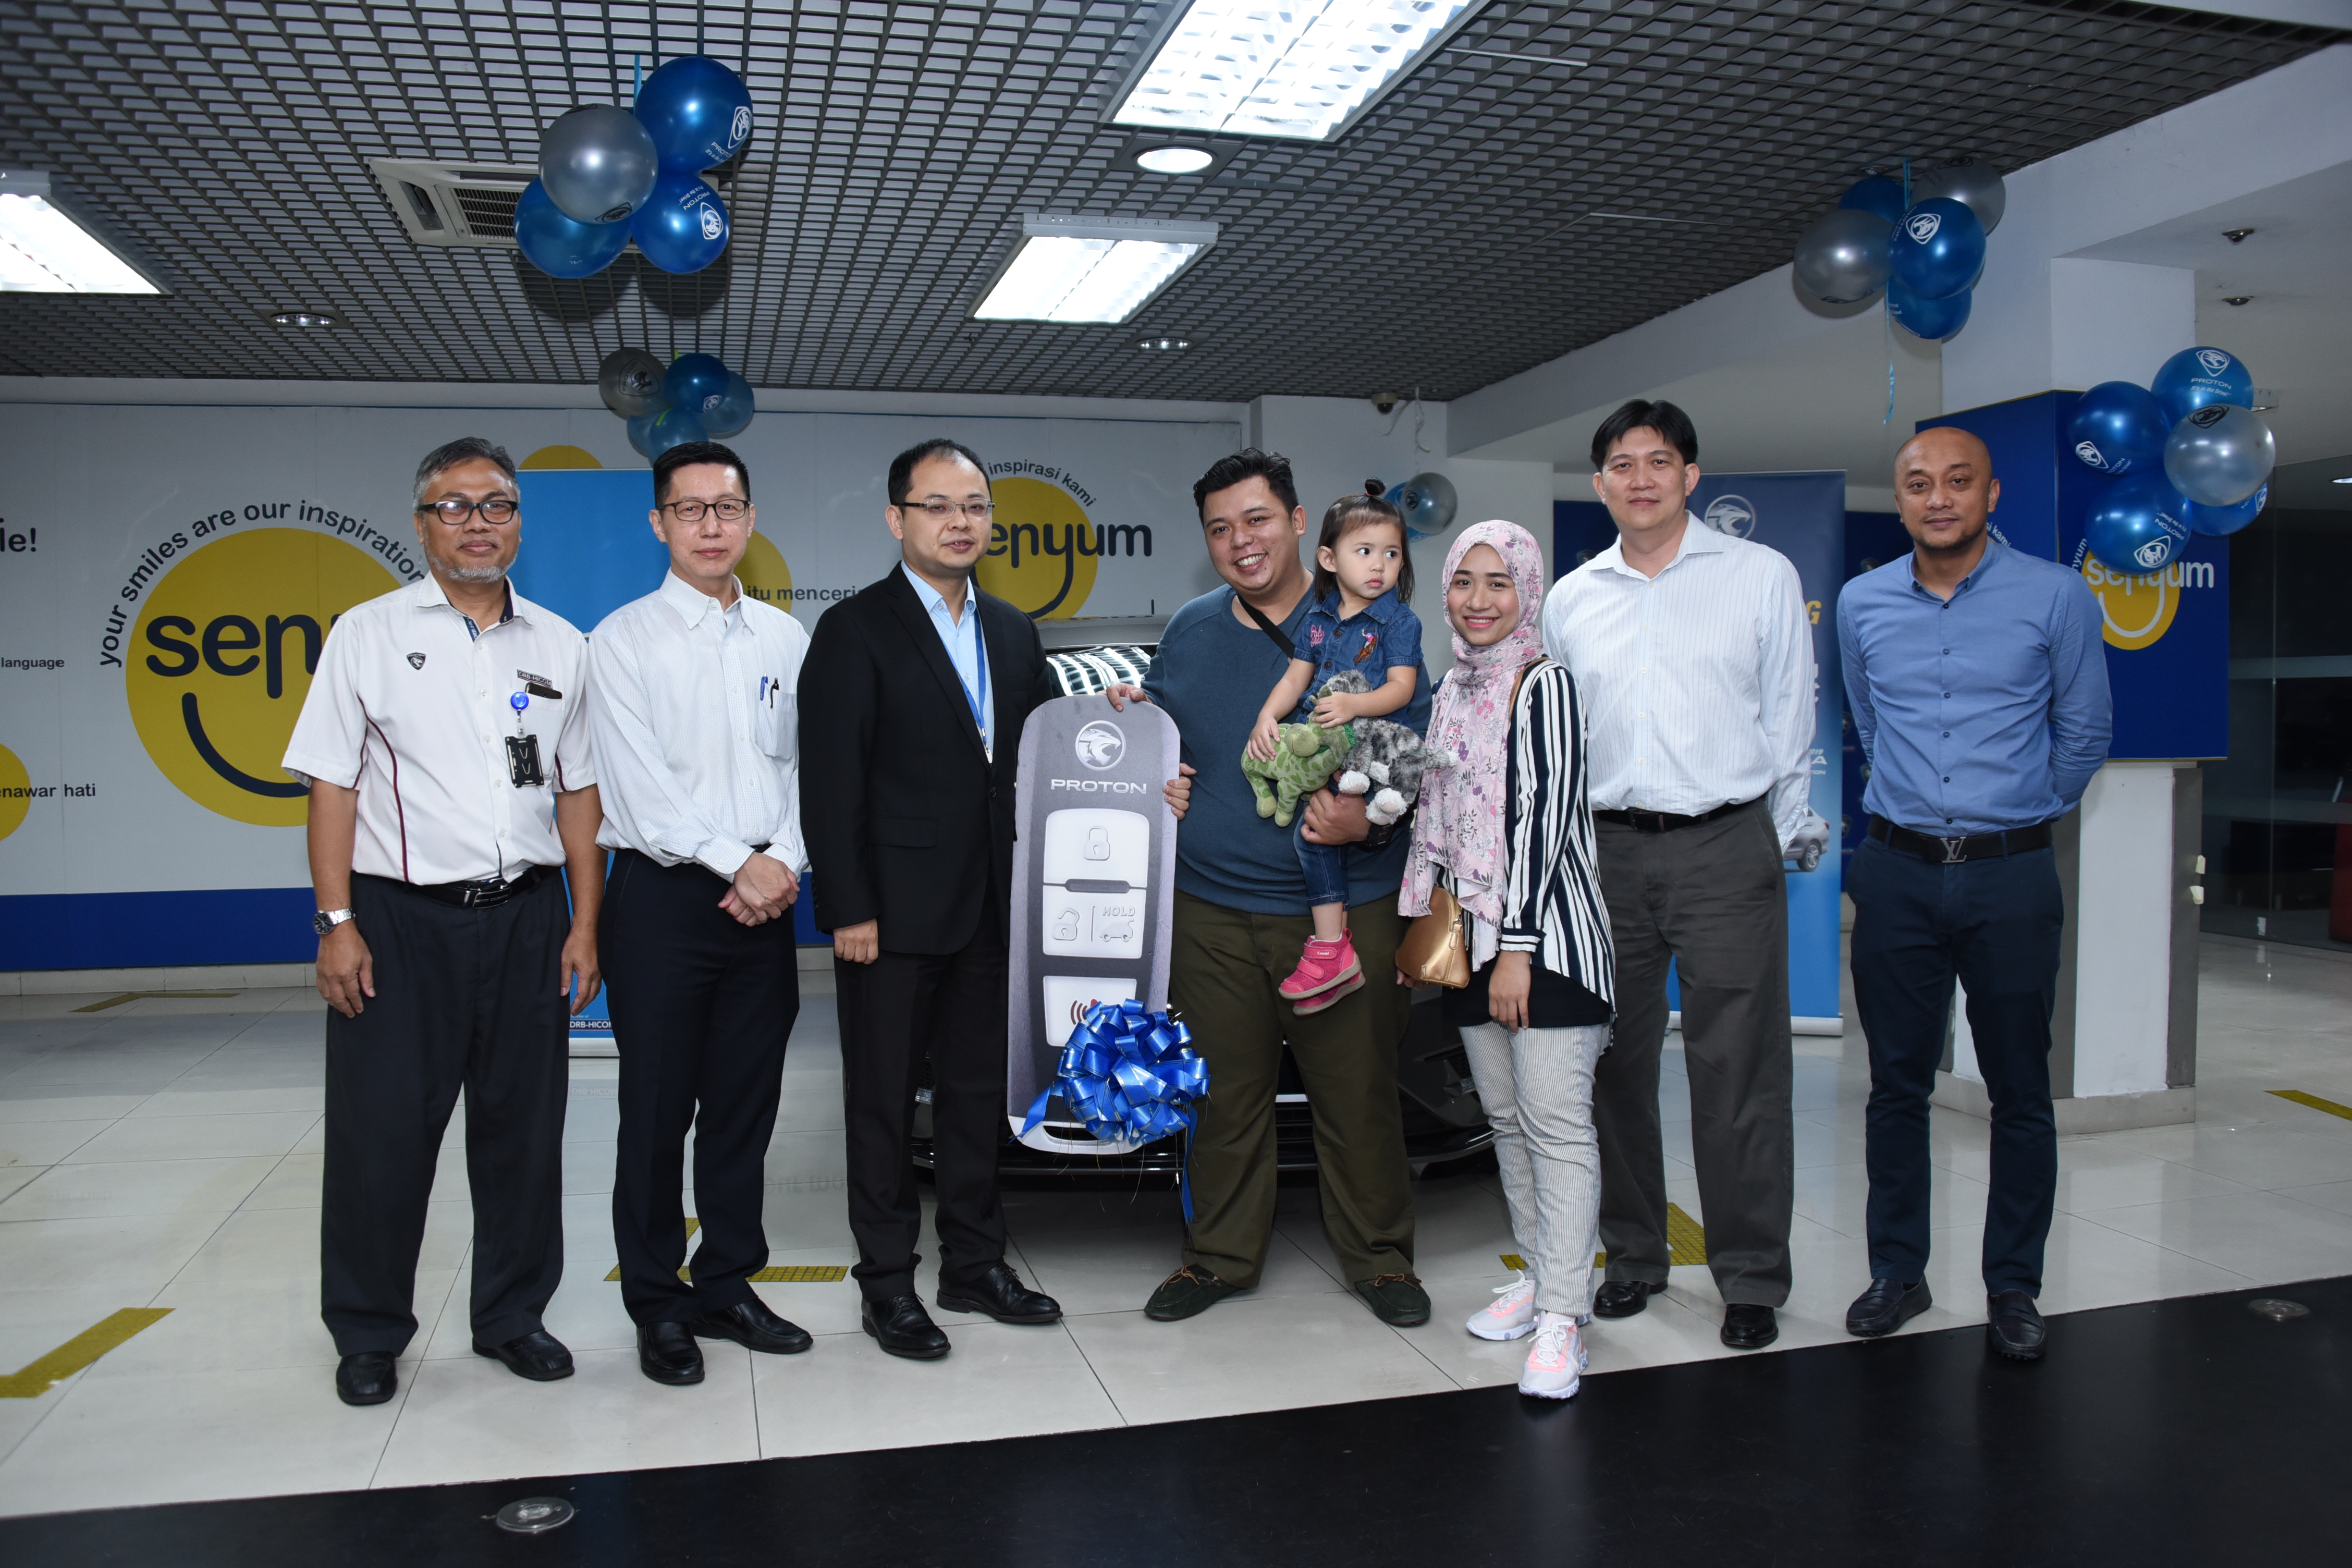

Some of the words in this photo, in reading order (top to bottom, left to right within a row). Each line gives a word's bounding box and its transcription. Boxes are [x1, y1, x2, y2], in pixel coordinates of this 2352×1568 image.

[711, 141, 732, 157] PROTO
[683, 191, 710, 211] PROTON
[2190, 378, 2232, 390] PROTON
[988, 459, 1061, 480] inspirasi
[1062, 473, 1097, 507] kami
[2154, 519, 2185, 541] PROTON
[986, 523, 1153, 569] enyum
[2072, 538, 2087, 570] nyum
[100, 604, 128, 668] your
[121, 532, 189, 602] smiles
[192, 510, 237, 538] are
[243, 503, 291, 521] our
[777, 585, 863, 601] menceri
[1, 657, 65, 670] language
[519, 671, 552, 687] DRB-HICOM
[0, 787, 56, 798] nawar
[64, 783, 96, 797] hati
[1050, 779, 1147, 794] PROTON
[1102, 905, 1135, 917] HOLD
